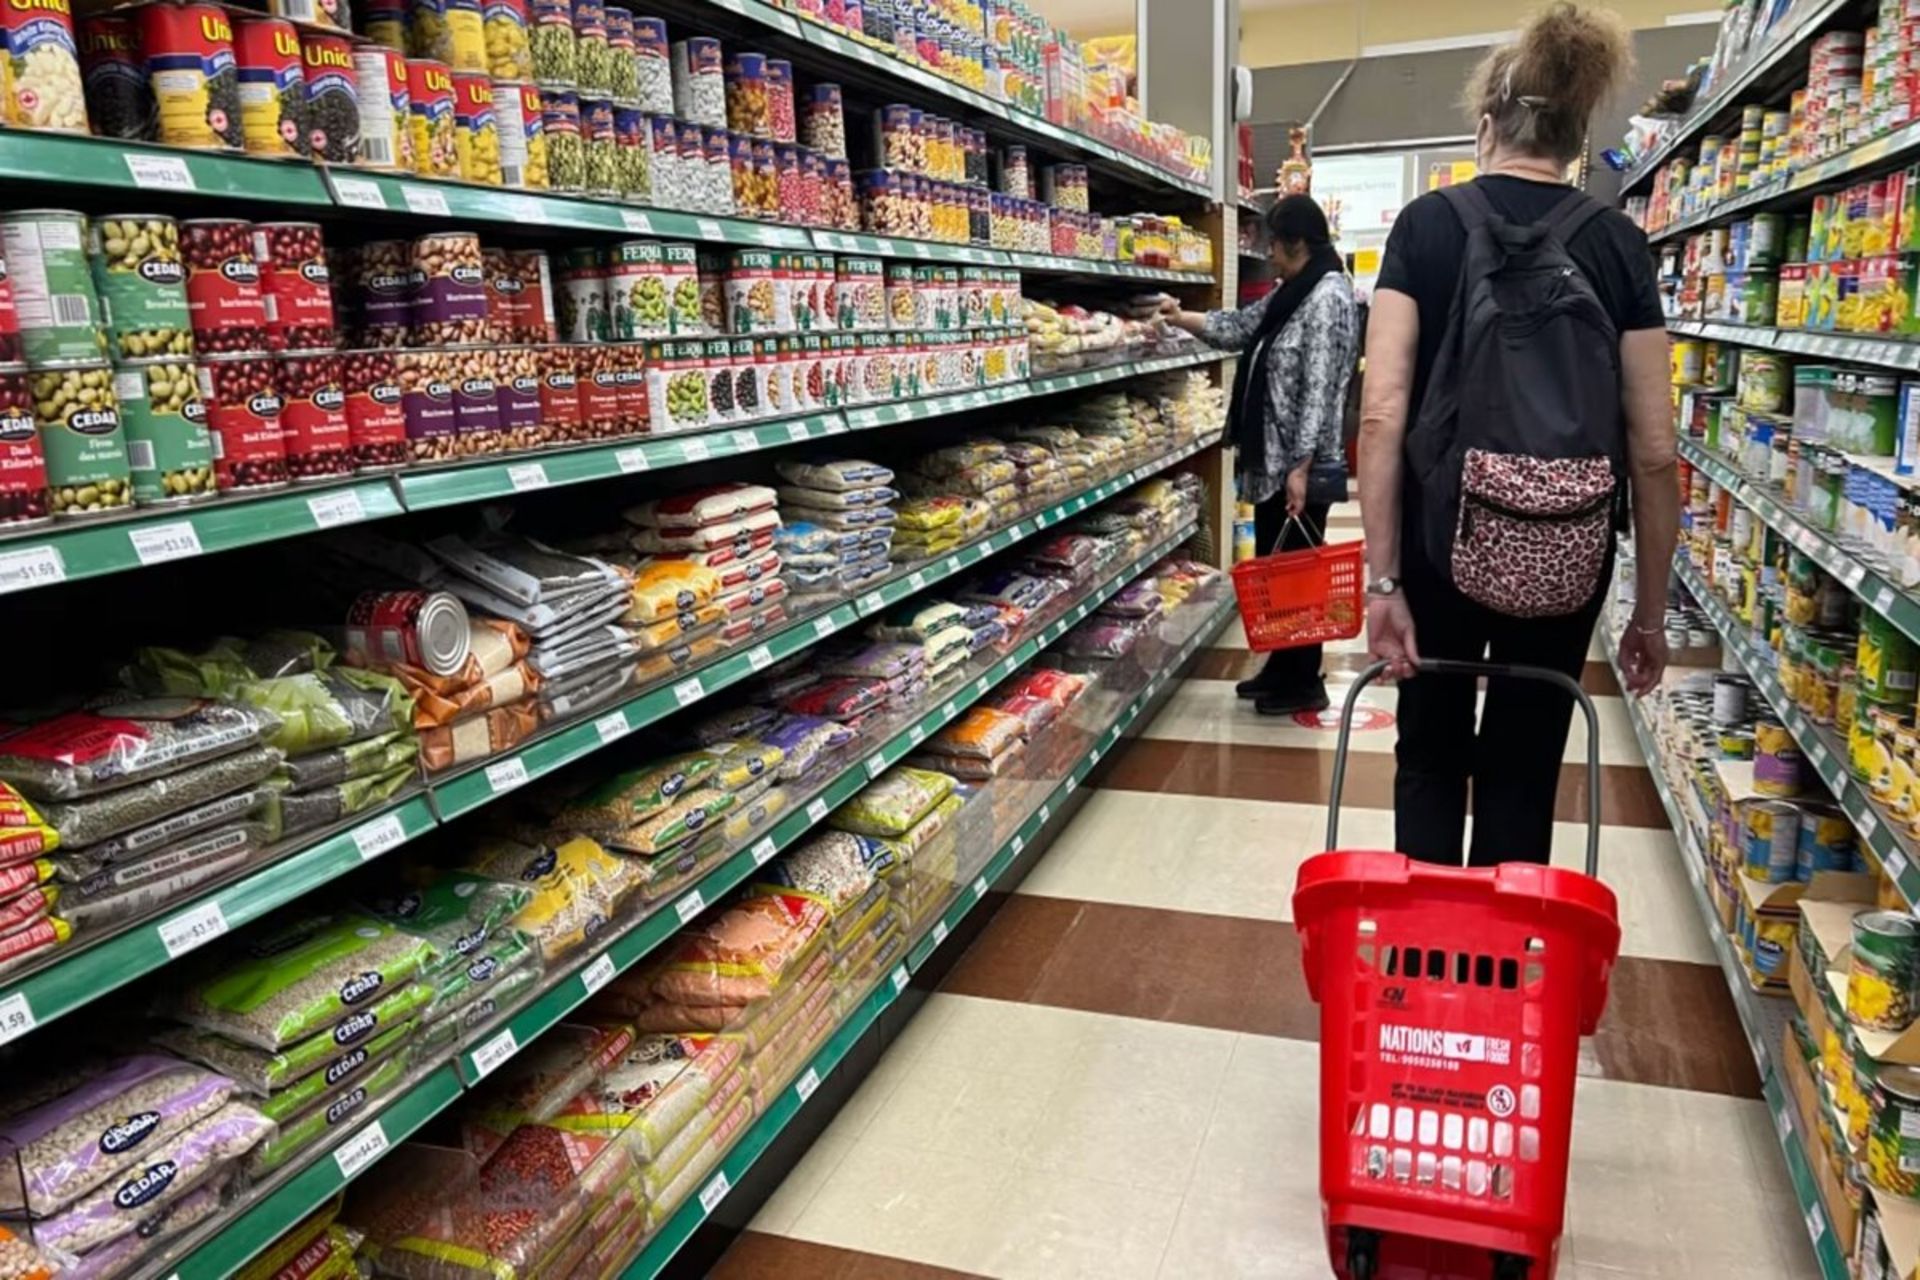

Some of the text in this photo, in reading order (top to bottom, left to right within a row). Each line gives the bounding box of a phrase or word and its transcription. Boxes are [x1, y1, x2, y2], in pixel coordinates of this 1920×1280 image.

[343, 972, 380, 1001] CEDAR
[336, 1012, 375, 1042] CEDAR
[1380, 1023, 1443, 1057] NATIONS
[328, 1051, 366, 1082] CEDAR
[328, 1089, 365, 1122] CEDAR
[118, 1164, 173, 1205] CEDAR
